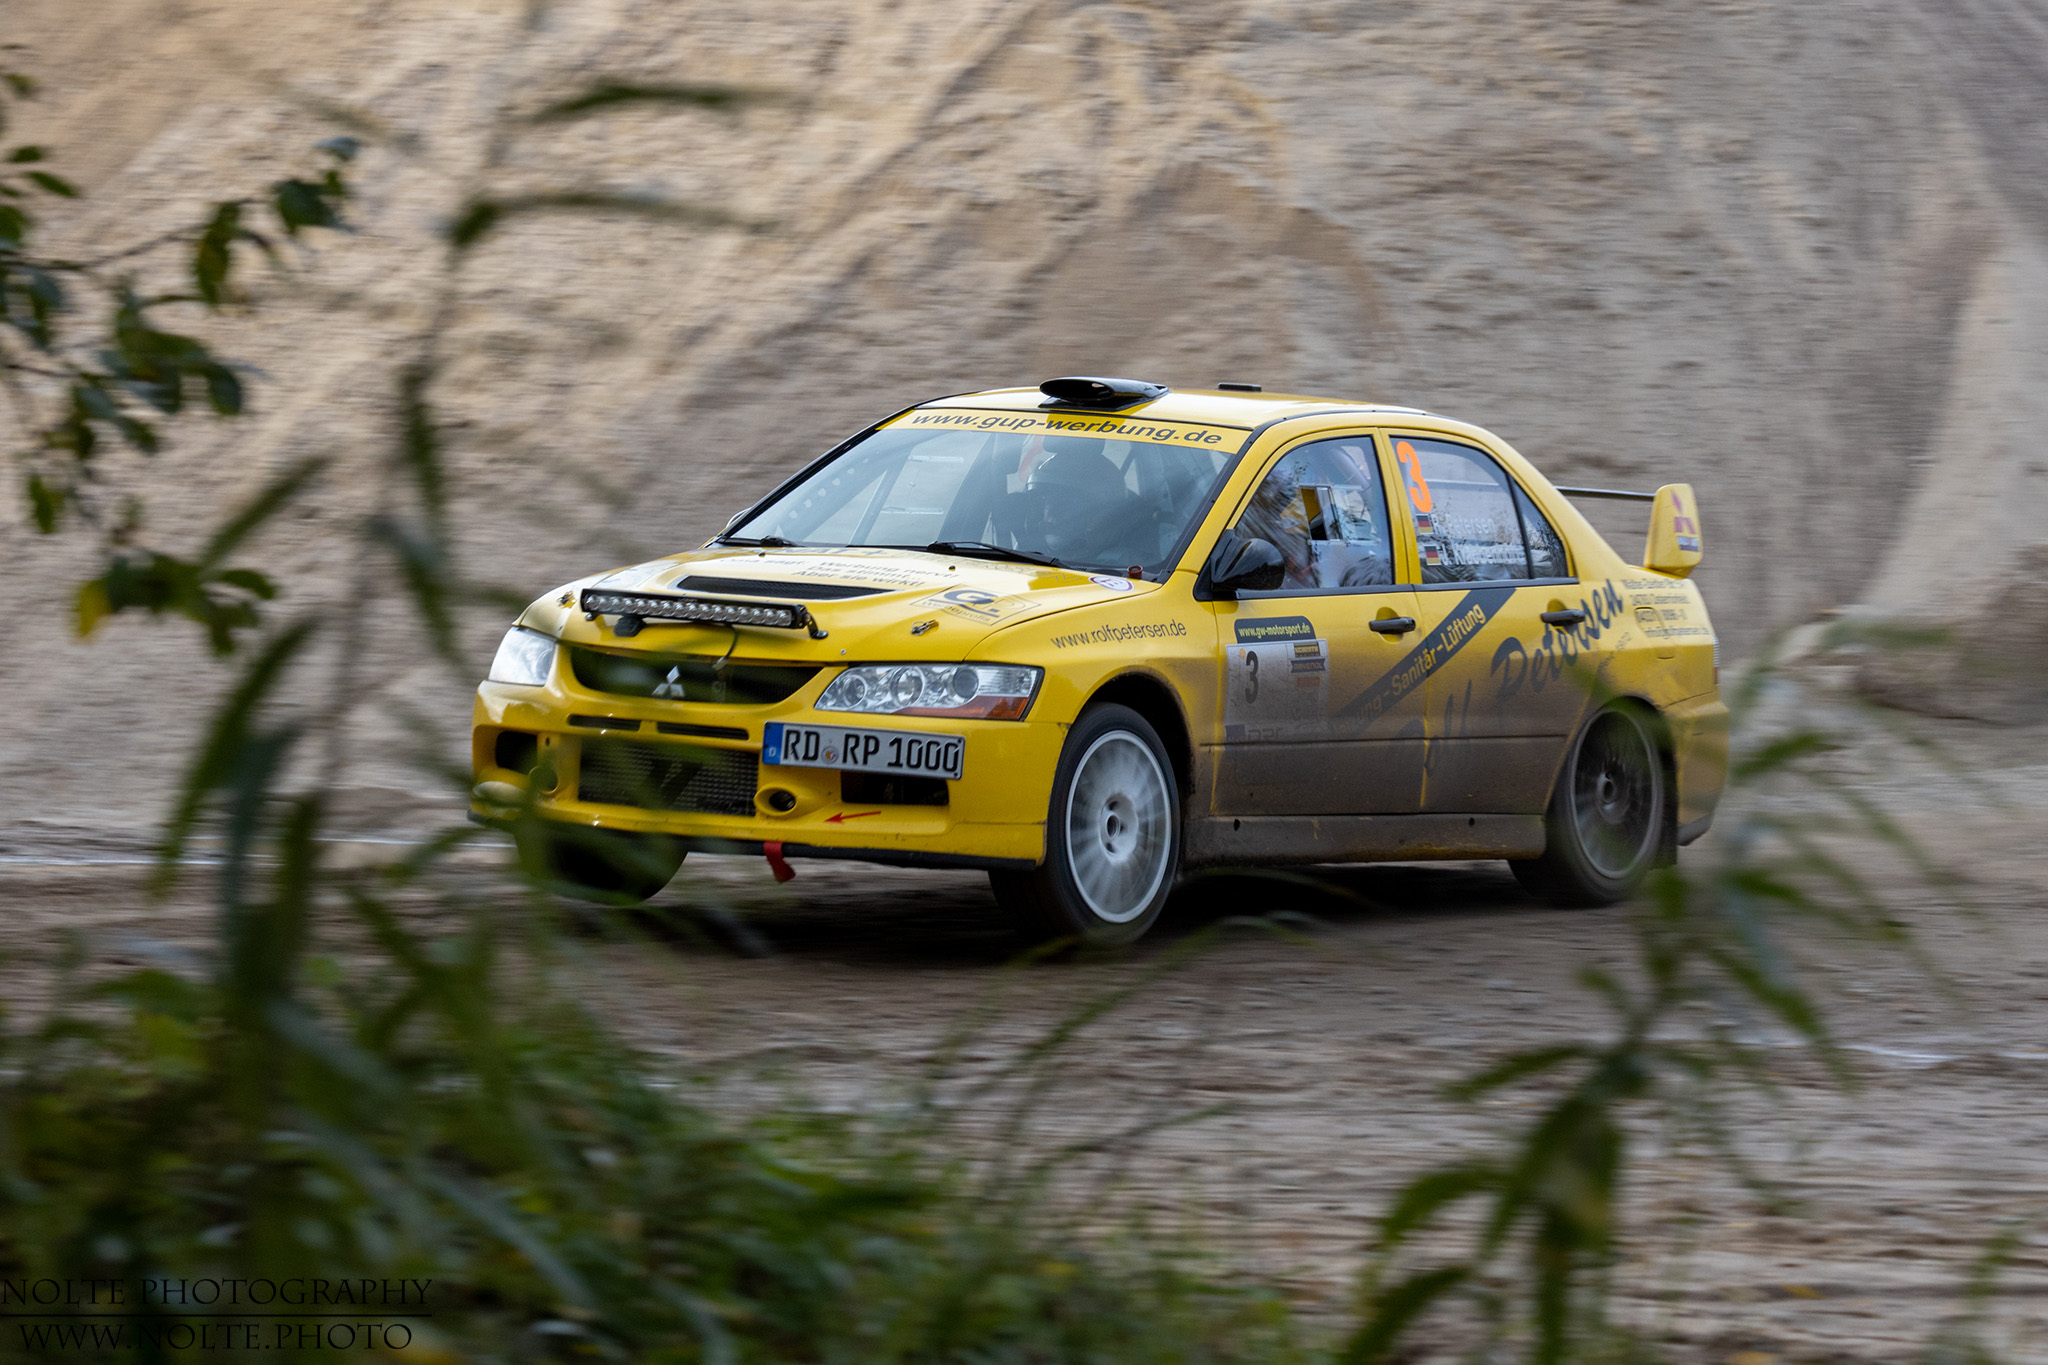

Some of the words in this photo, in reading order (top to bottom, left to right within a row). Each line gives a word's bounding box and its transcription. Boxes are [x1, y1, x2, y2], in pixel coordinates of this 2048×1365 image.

[911, 411, 1223, 445] www.gup-werbung.de
[1396, 440, 1433, 513] 3
[1050, 618, 1188, 650] www.rolfpetersen.de
[1237, 622, 1312, 640] www.gw-motorsport.de
[1245, 650, 1259, 705] 3
[783, 728, 821, 761] RD
[842, 732, 880, 766] RP
[887, 737, 961, 773] 1000
